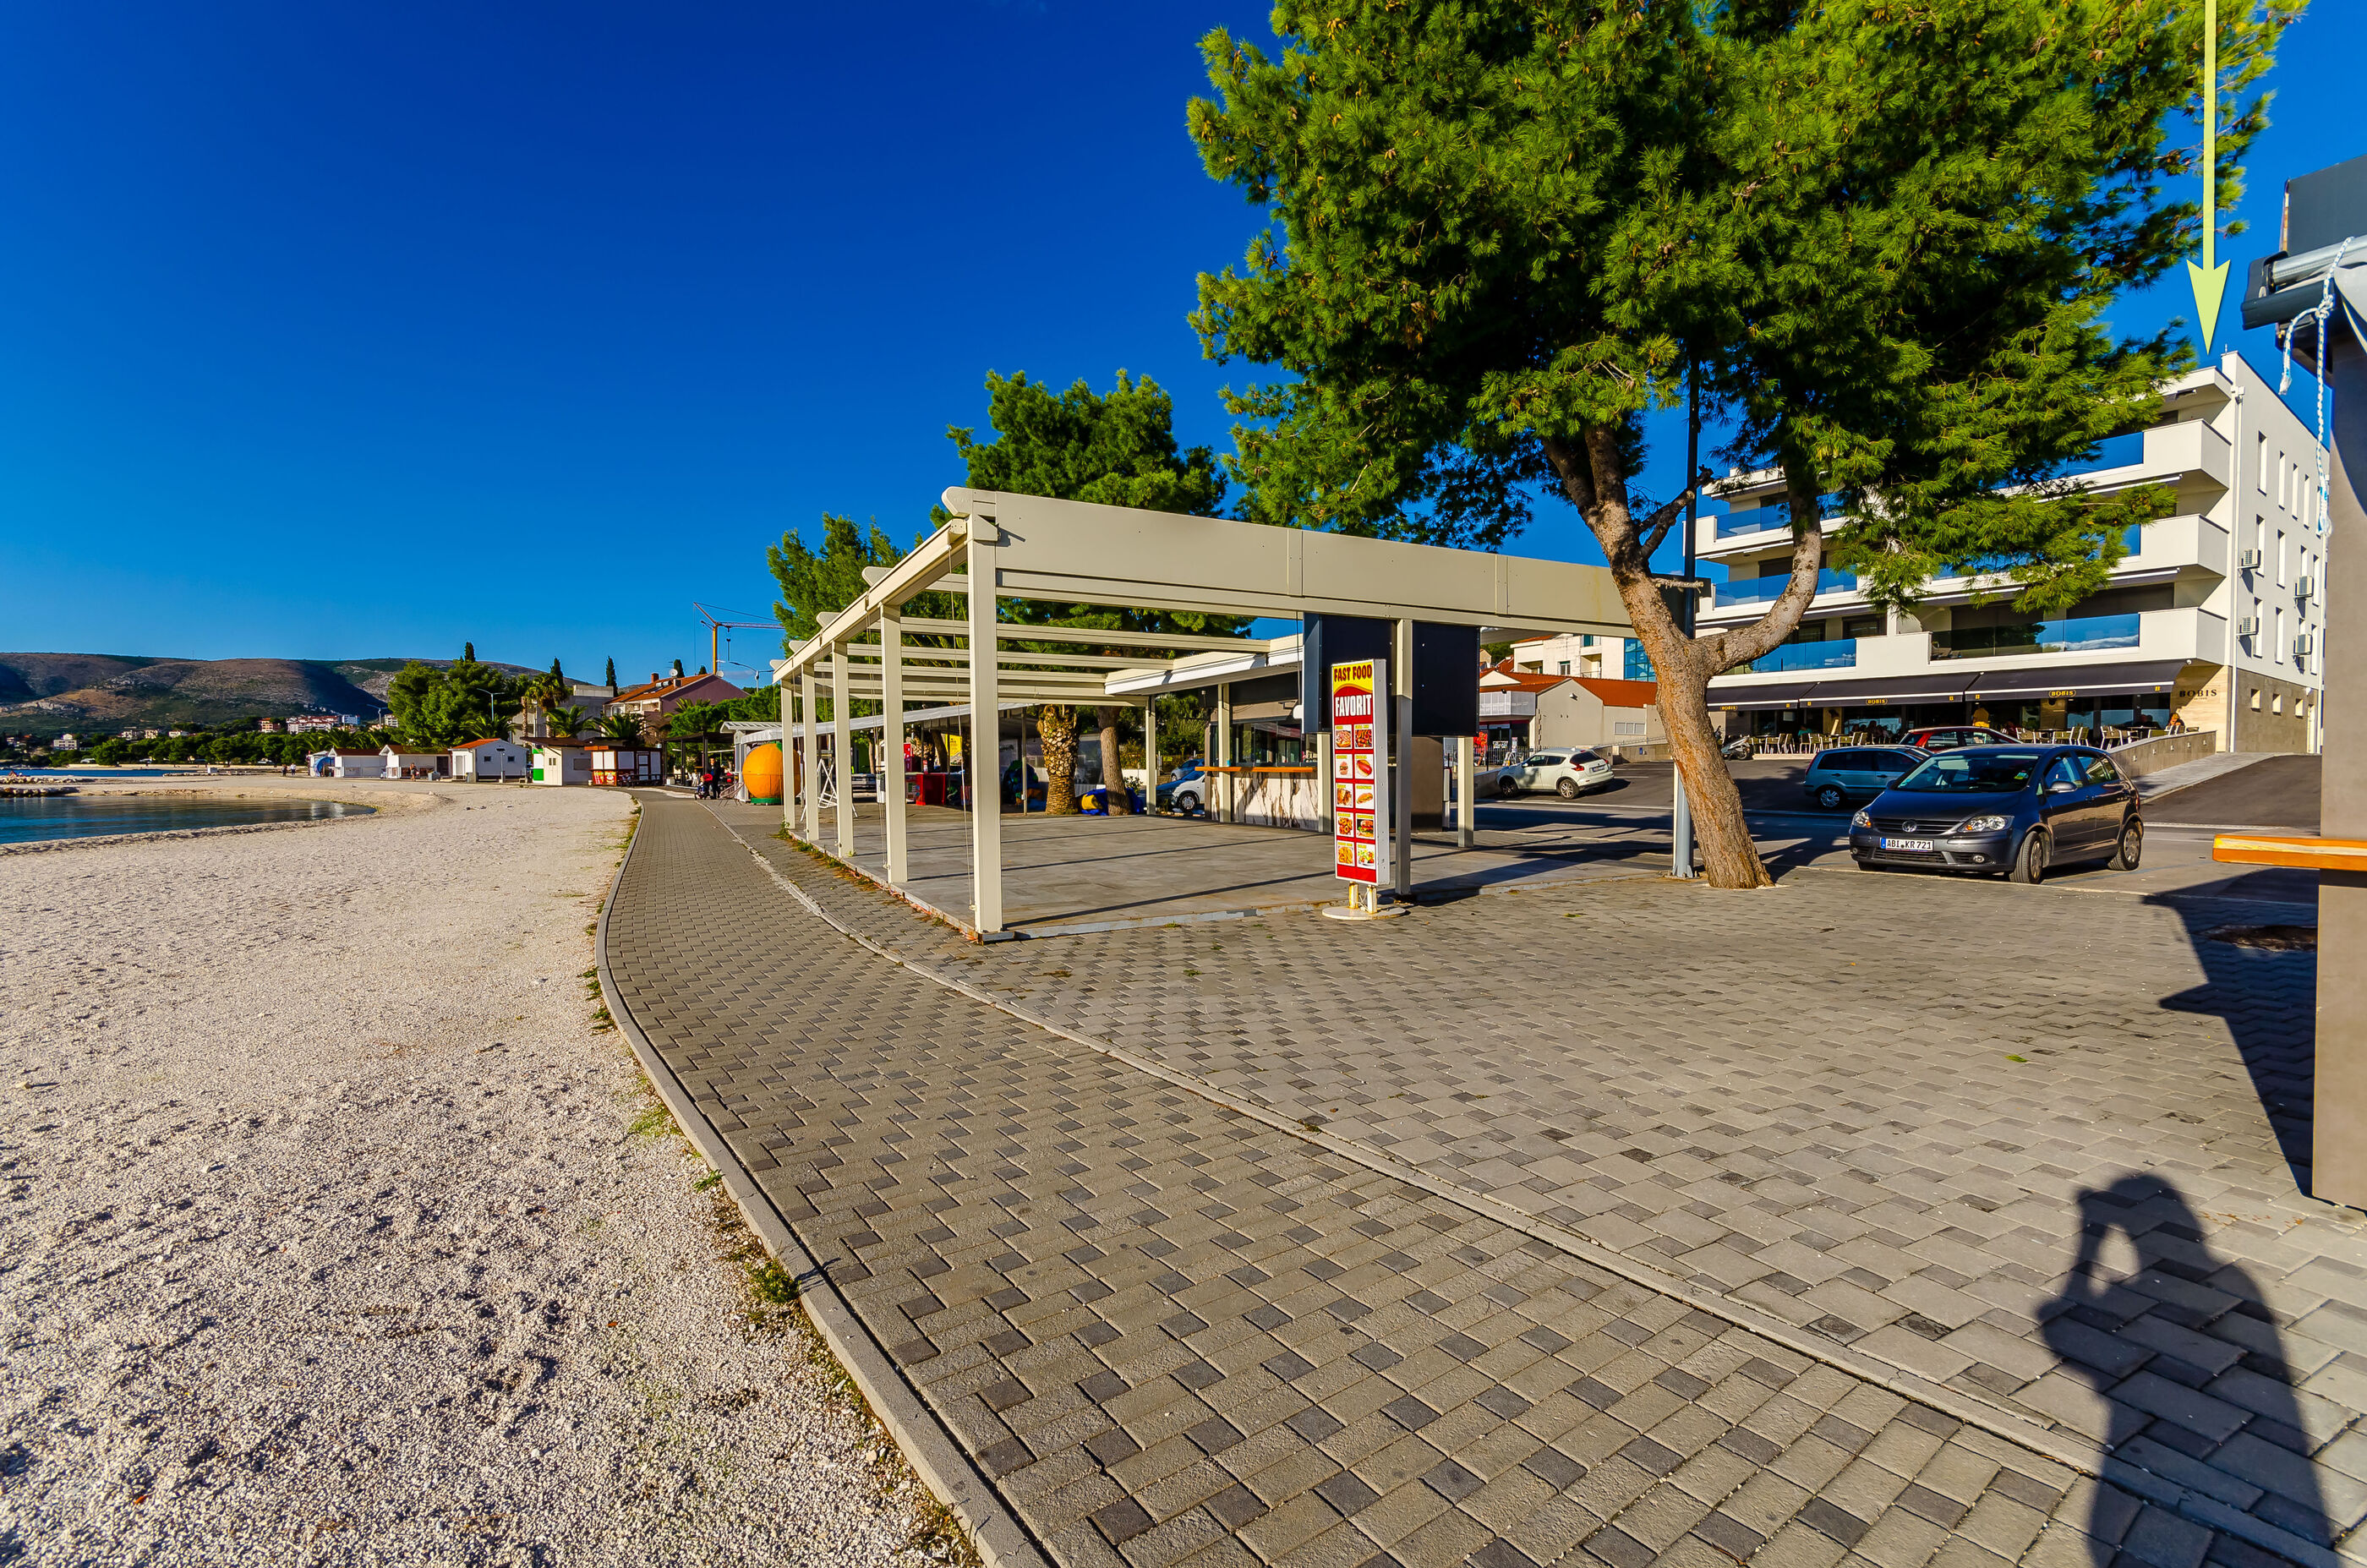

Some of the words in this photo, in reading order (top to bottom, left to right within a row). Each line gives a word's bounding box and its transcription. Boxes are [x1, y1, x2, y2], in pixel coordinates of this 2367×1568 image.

[1334, 667, 1351, 682] FAST
[1353, 664, 1372, 680] FOOD
[2179, 689, 2217, 697] BOBIS
[1335, 694, 1372, 717] FAVORIT
